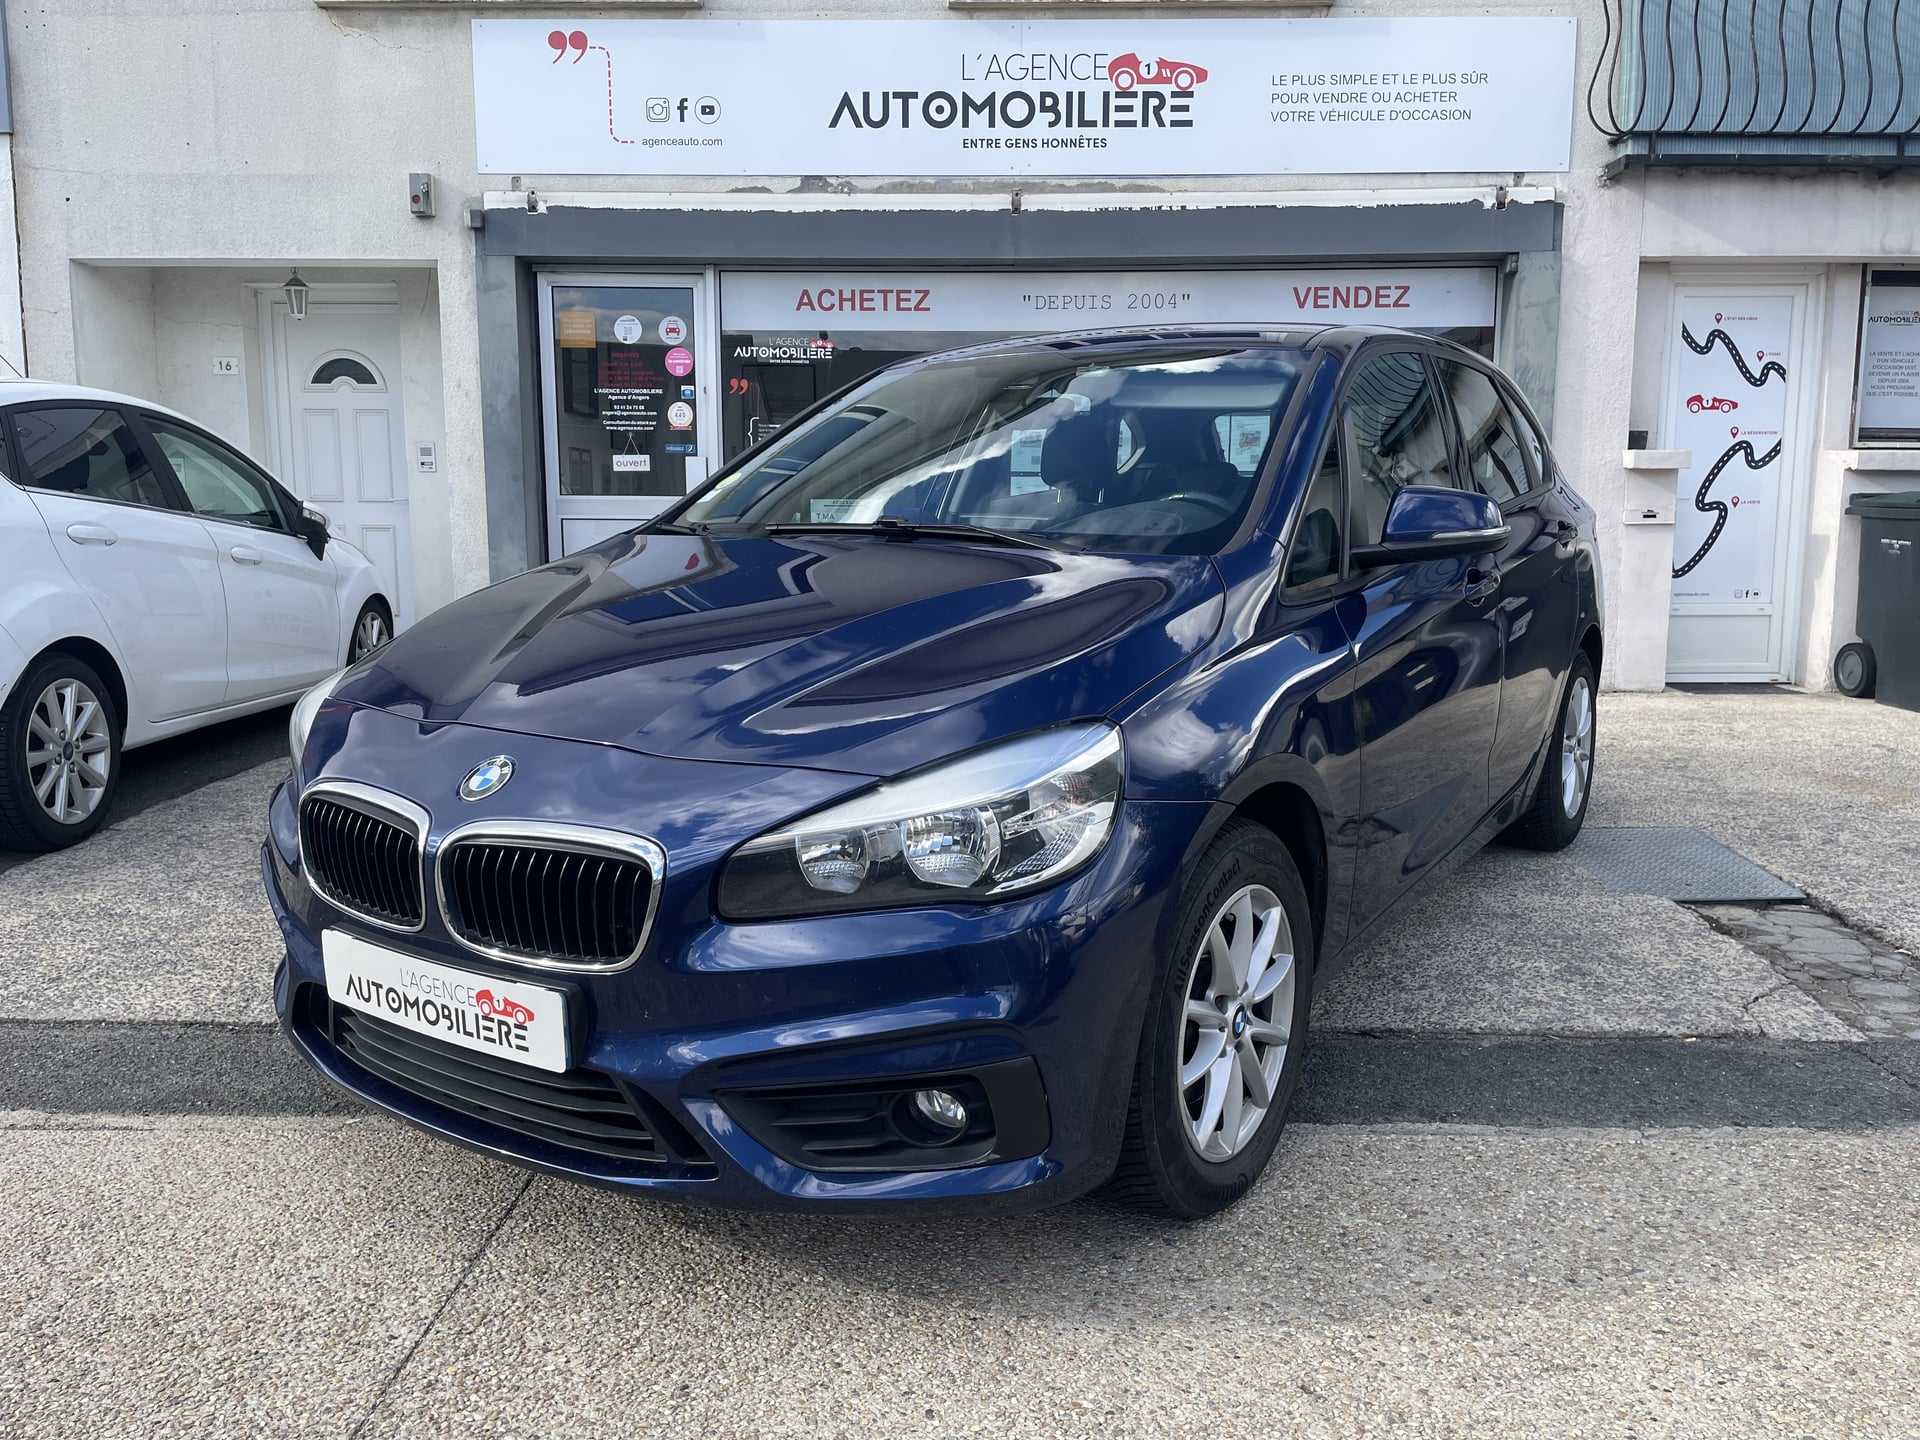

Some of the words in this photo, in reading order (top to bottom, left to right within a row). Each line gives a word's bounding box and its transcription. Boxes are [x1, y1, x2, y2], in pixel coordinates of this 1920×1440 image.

[961, 53, 1108, 81] L'AGENCE
[1271, 75, 1287, 86] LE
[1292, 75, 1326, 86] PLUS
[1330, 74, 1378, 85] SIMPLE
[1382, 74, 1399, 85] ET
[1403, 74, 1418, 85] LE
[1422, 73, 1457, 85] PLUS
[1460, 70, 1489, 84] SÛR
[1271, 93, 1309, 104] POUR
[1313, 92, 1367, 103] VENDRE
[1371, 92, 1391, 103] OU
[1394, 91, 1458, 103] ACHETER
[1270, 111, 1315, 122] VOTRE
[1319, 108, 1385, 121] VÉHICULE
[1389, 109, 1472, 121] D'OCCASION
[641, 137, 723, 148] agenceauto.com
[962, 137, 1001, 149] ENTRE
[1004, 138, 1038, 149] GENS
[1041, 134, 1108, 149] HONNÊTES
[795, 288, 931, 312] ACHETEZ
[1022, 294, 1112, 310] "DEPUIS
[1127, 293, 1191, 309] 2004"
[1292, 285, 1411, 309] VENDEZ
[218, 360, 232, 371] 16
[615, 459, 647, 467] ouvert
[400, 967, 476, 1008] L'AGENCE
